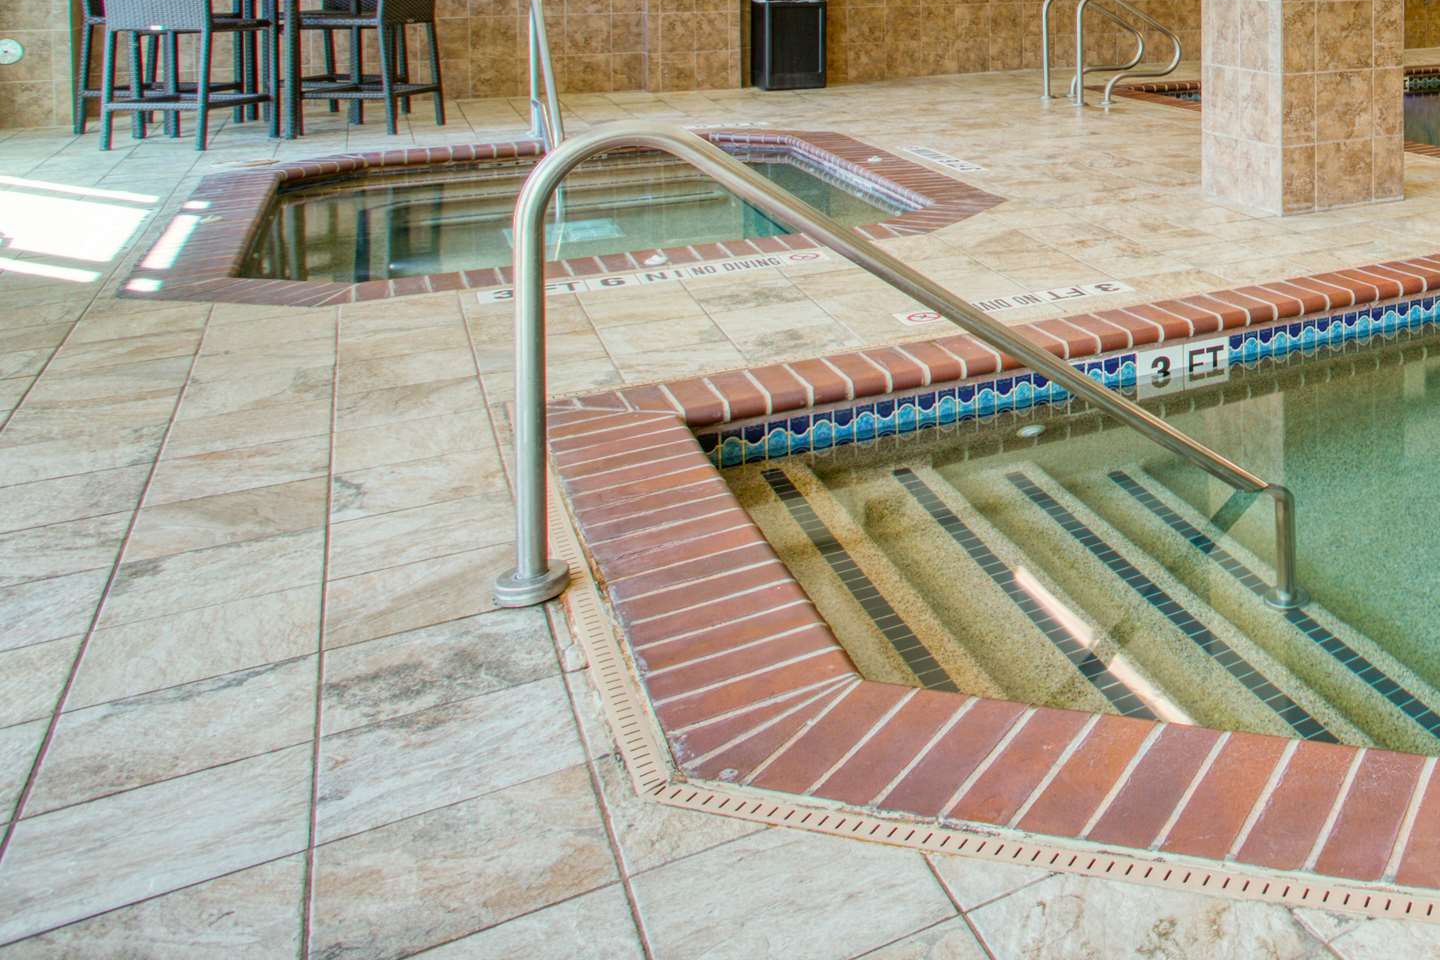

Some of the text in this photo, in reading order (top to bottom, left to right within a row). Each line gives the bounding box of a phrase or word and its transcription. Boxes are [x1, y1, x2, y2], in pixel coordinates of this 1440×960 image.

[600, 277, 625, 286] 6
[691, 265, 716, 275] NO
[722, 257, 781, 272] DIVING
[1012, 294, 1042, 304] NO
[1047, 287, 1086, 300] FT
[1188, 345, 1224, 372] FT
